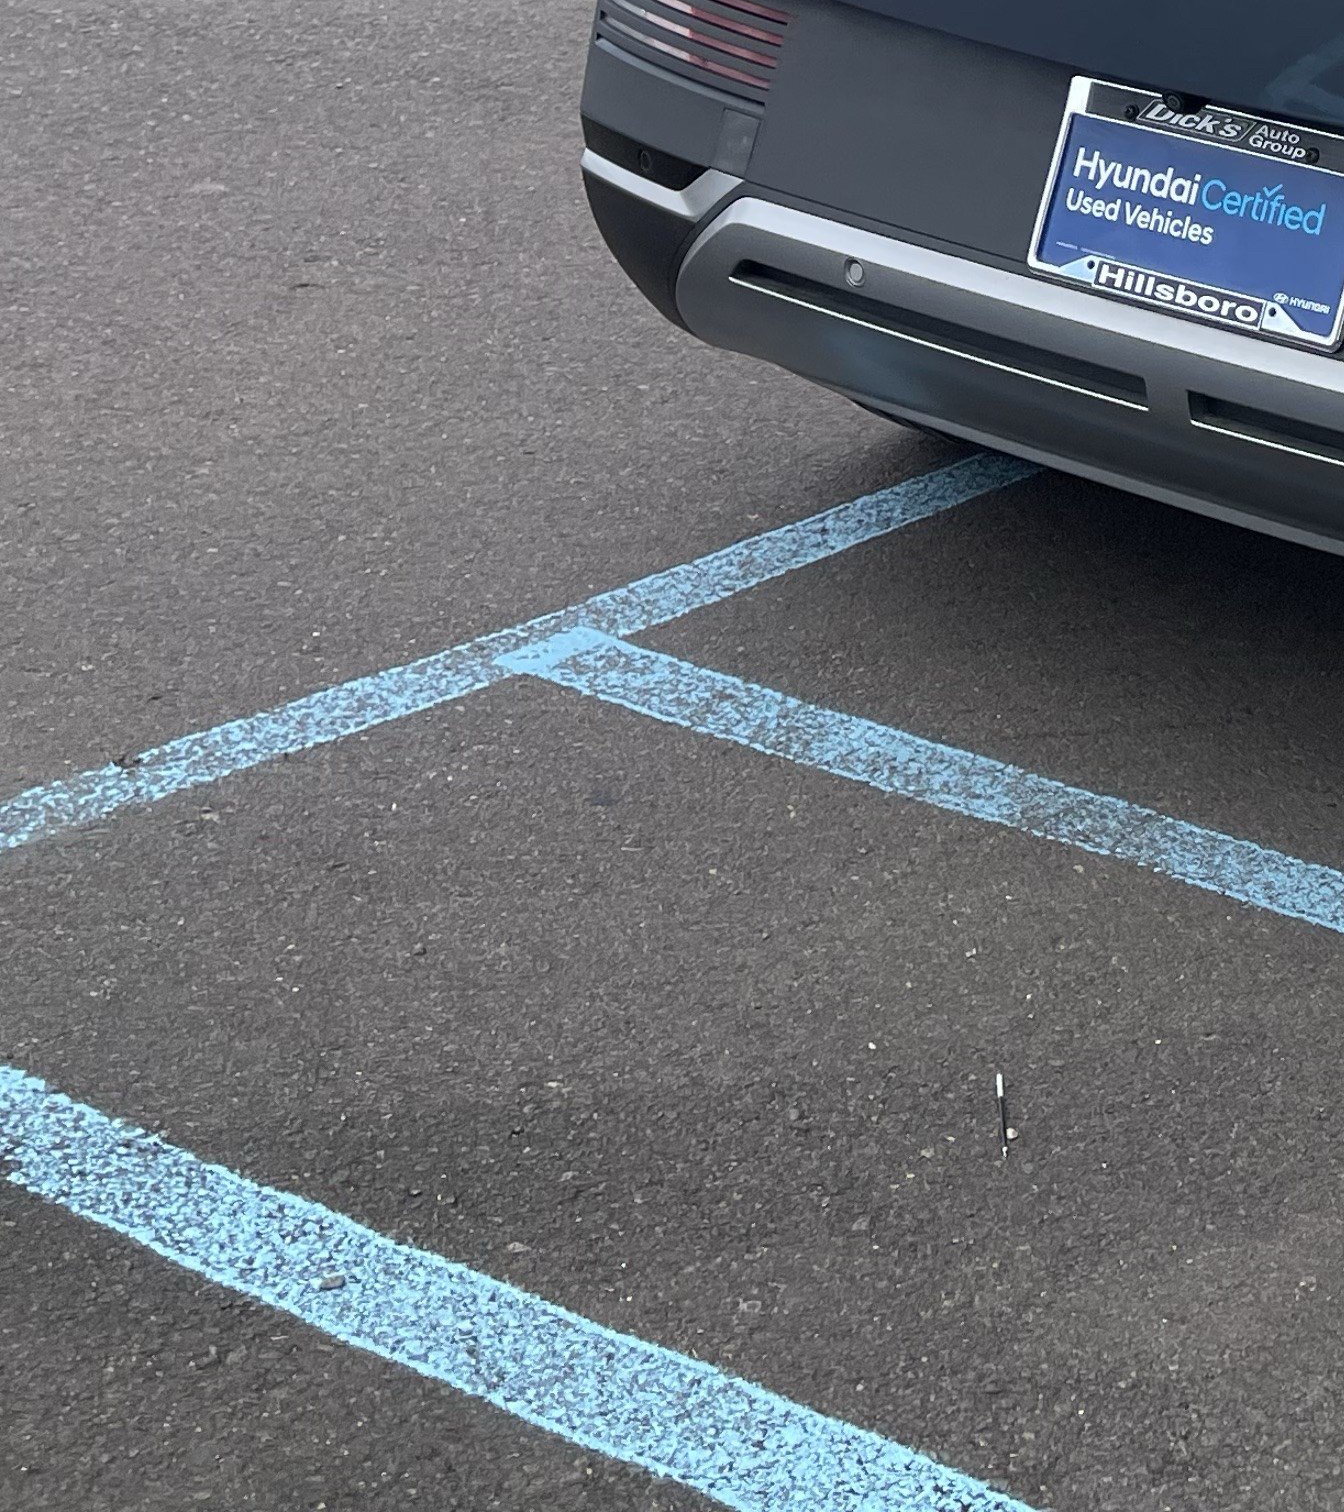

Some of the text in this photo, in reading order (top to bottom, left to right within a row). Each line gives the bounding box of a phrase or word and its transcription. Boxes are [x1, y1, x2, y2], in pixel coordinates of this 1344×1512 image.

[1147, 103, 1301, 146] Dick's Auto
[1248, 135, 1308, 161] Group
[1065, 187, 1215, 246] Used Vehicles
[1072, 147, 1327, 236] Hyundai Certified
[1098, 262, 1260, 324] Hillsboro
[1288, 296, 1331, 315] HYUNDAI
